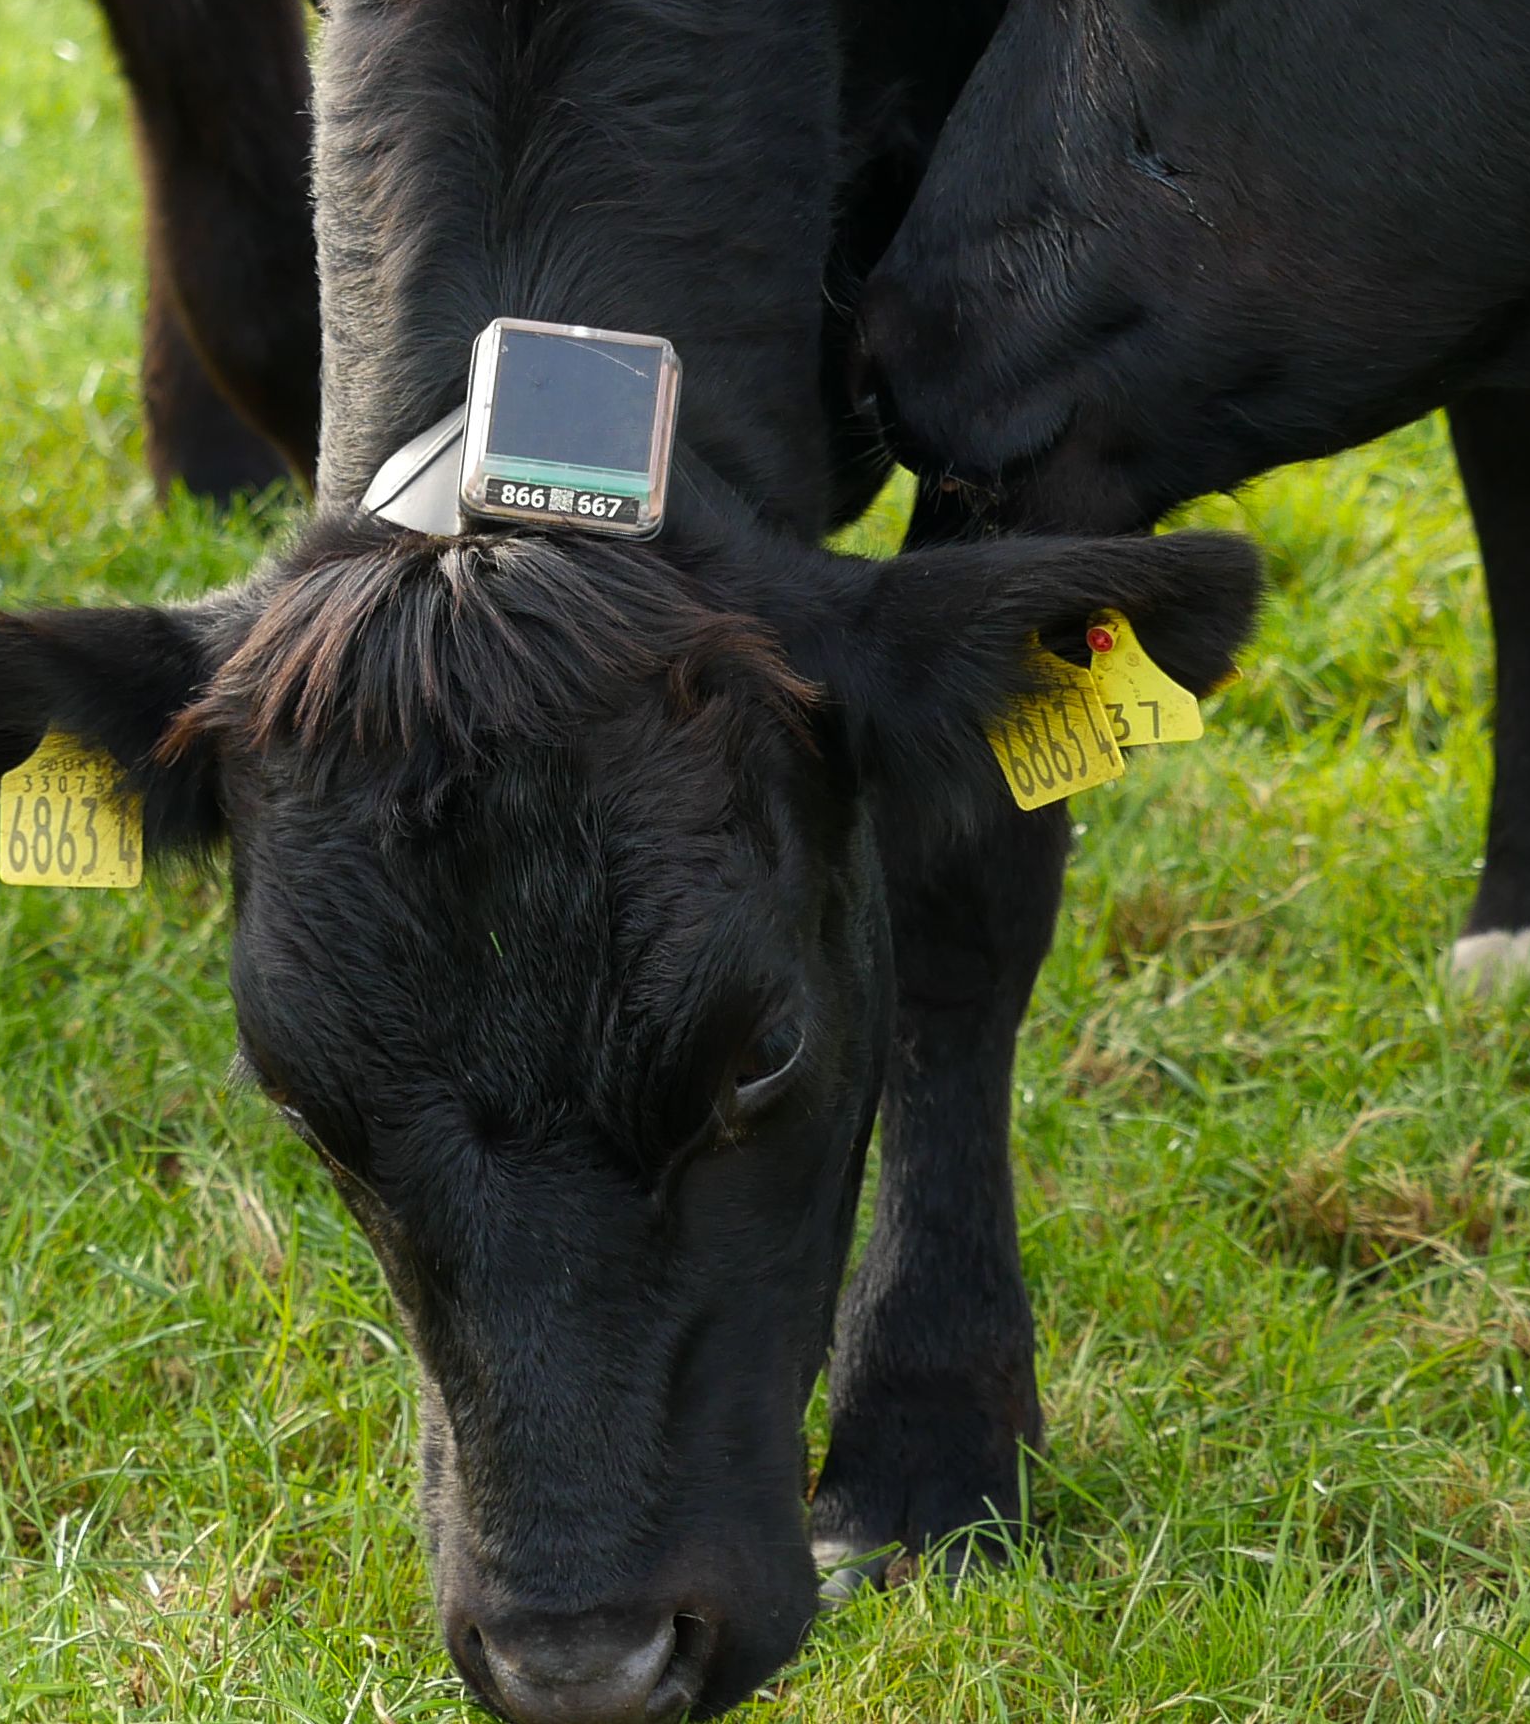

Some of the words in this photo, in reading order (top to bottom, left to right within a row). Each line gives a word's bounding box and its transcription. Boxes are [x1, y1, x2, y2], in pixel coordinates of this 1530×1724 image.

[501, 484, 545, 509] 866
[578, 494, 622, 518] 667
[1105, 701, 1159, 742] 37
